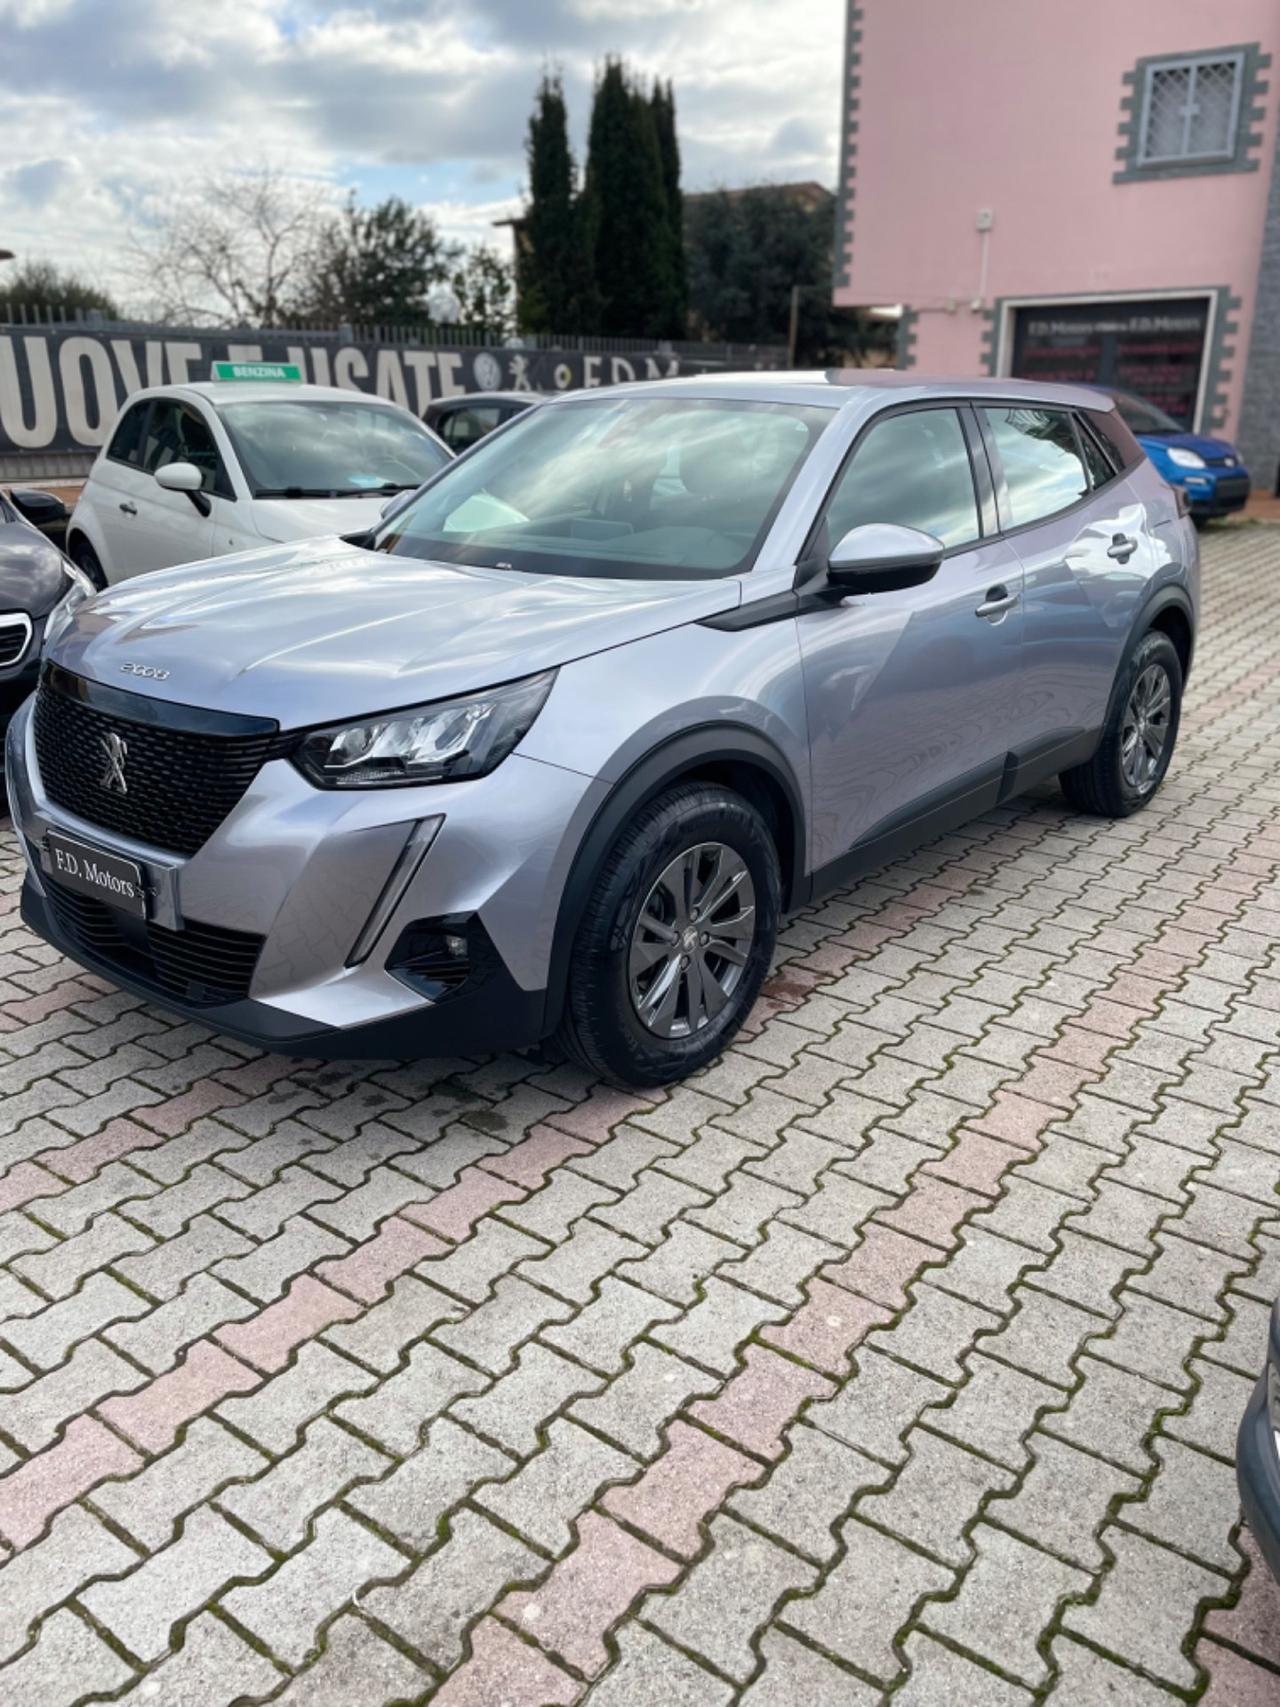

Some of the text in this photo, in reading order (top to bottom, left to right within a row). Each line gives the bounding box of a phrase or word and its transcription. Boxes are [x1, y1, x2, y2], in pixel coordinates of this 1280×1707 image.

[232, 365, 286, 379] BENZINA
[55, 848, 134, 898] F.D. Motors
